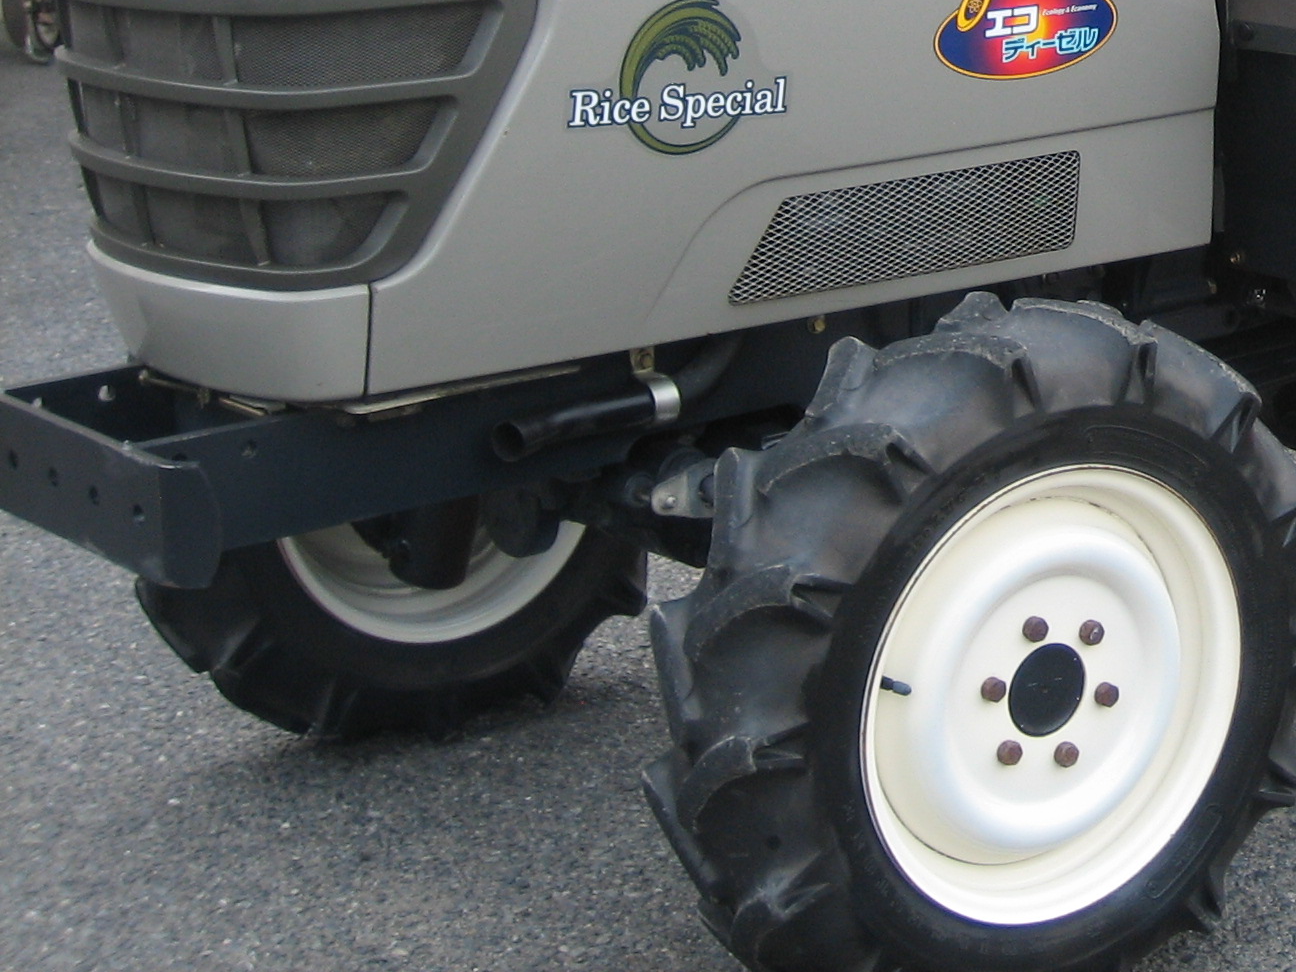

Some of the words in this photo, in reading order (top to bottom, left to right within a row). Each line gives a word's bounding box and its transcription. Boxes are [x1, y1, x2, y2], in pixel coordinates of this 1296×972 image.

[985, 5, 1038, 38] エコ
[1002, 28, 1098, 62] ディーゼル
[568, 88, 651, 127] Rice
[658, 76, 787, 128] Special
